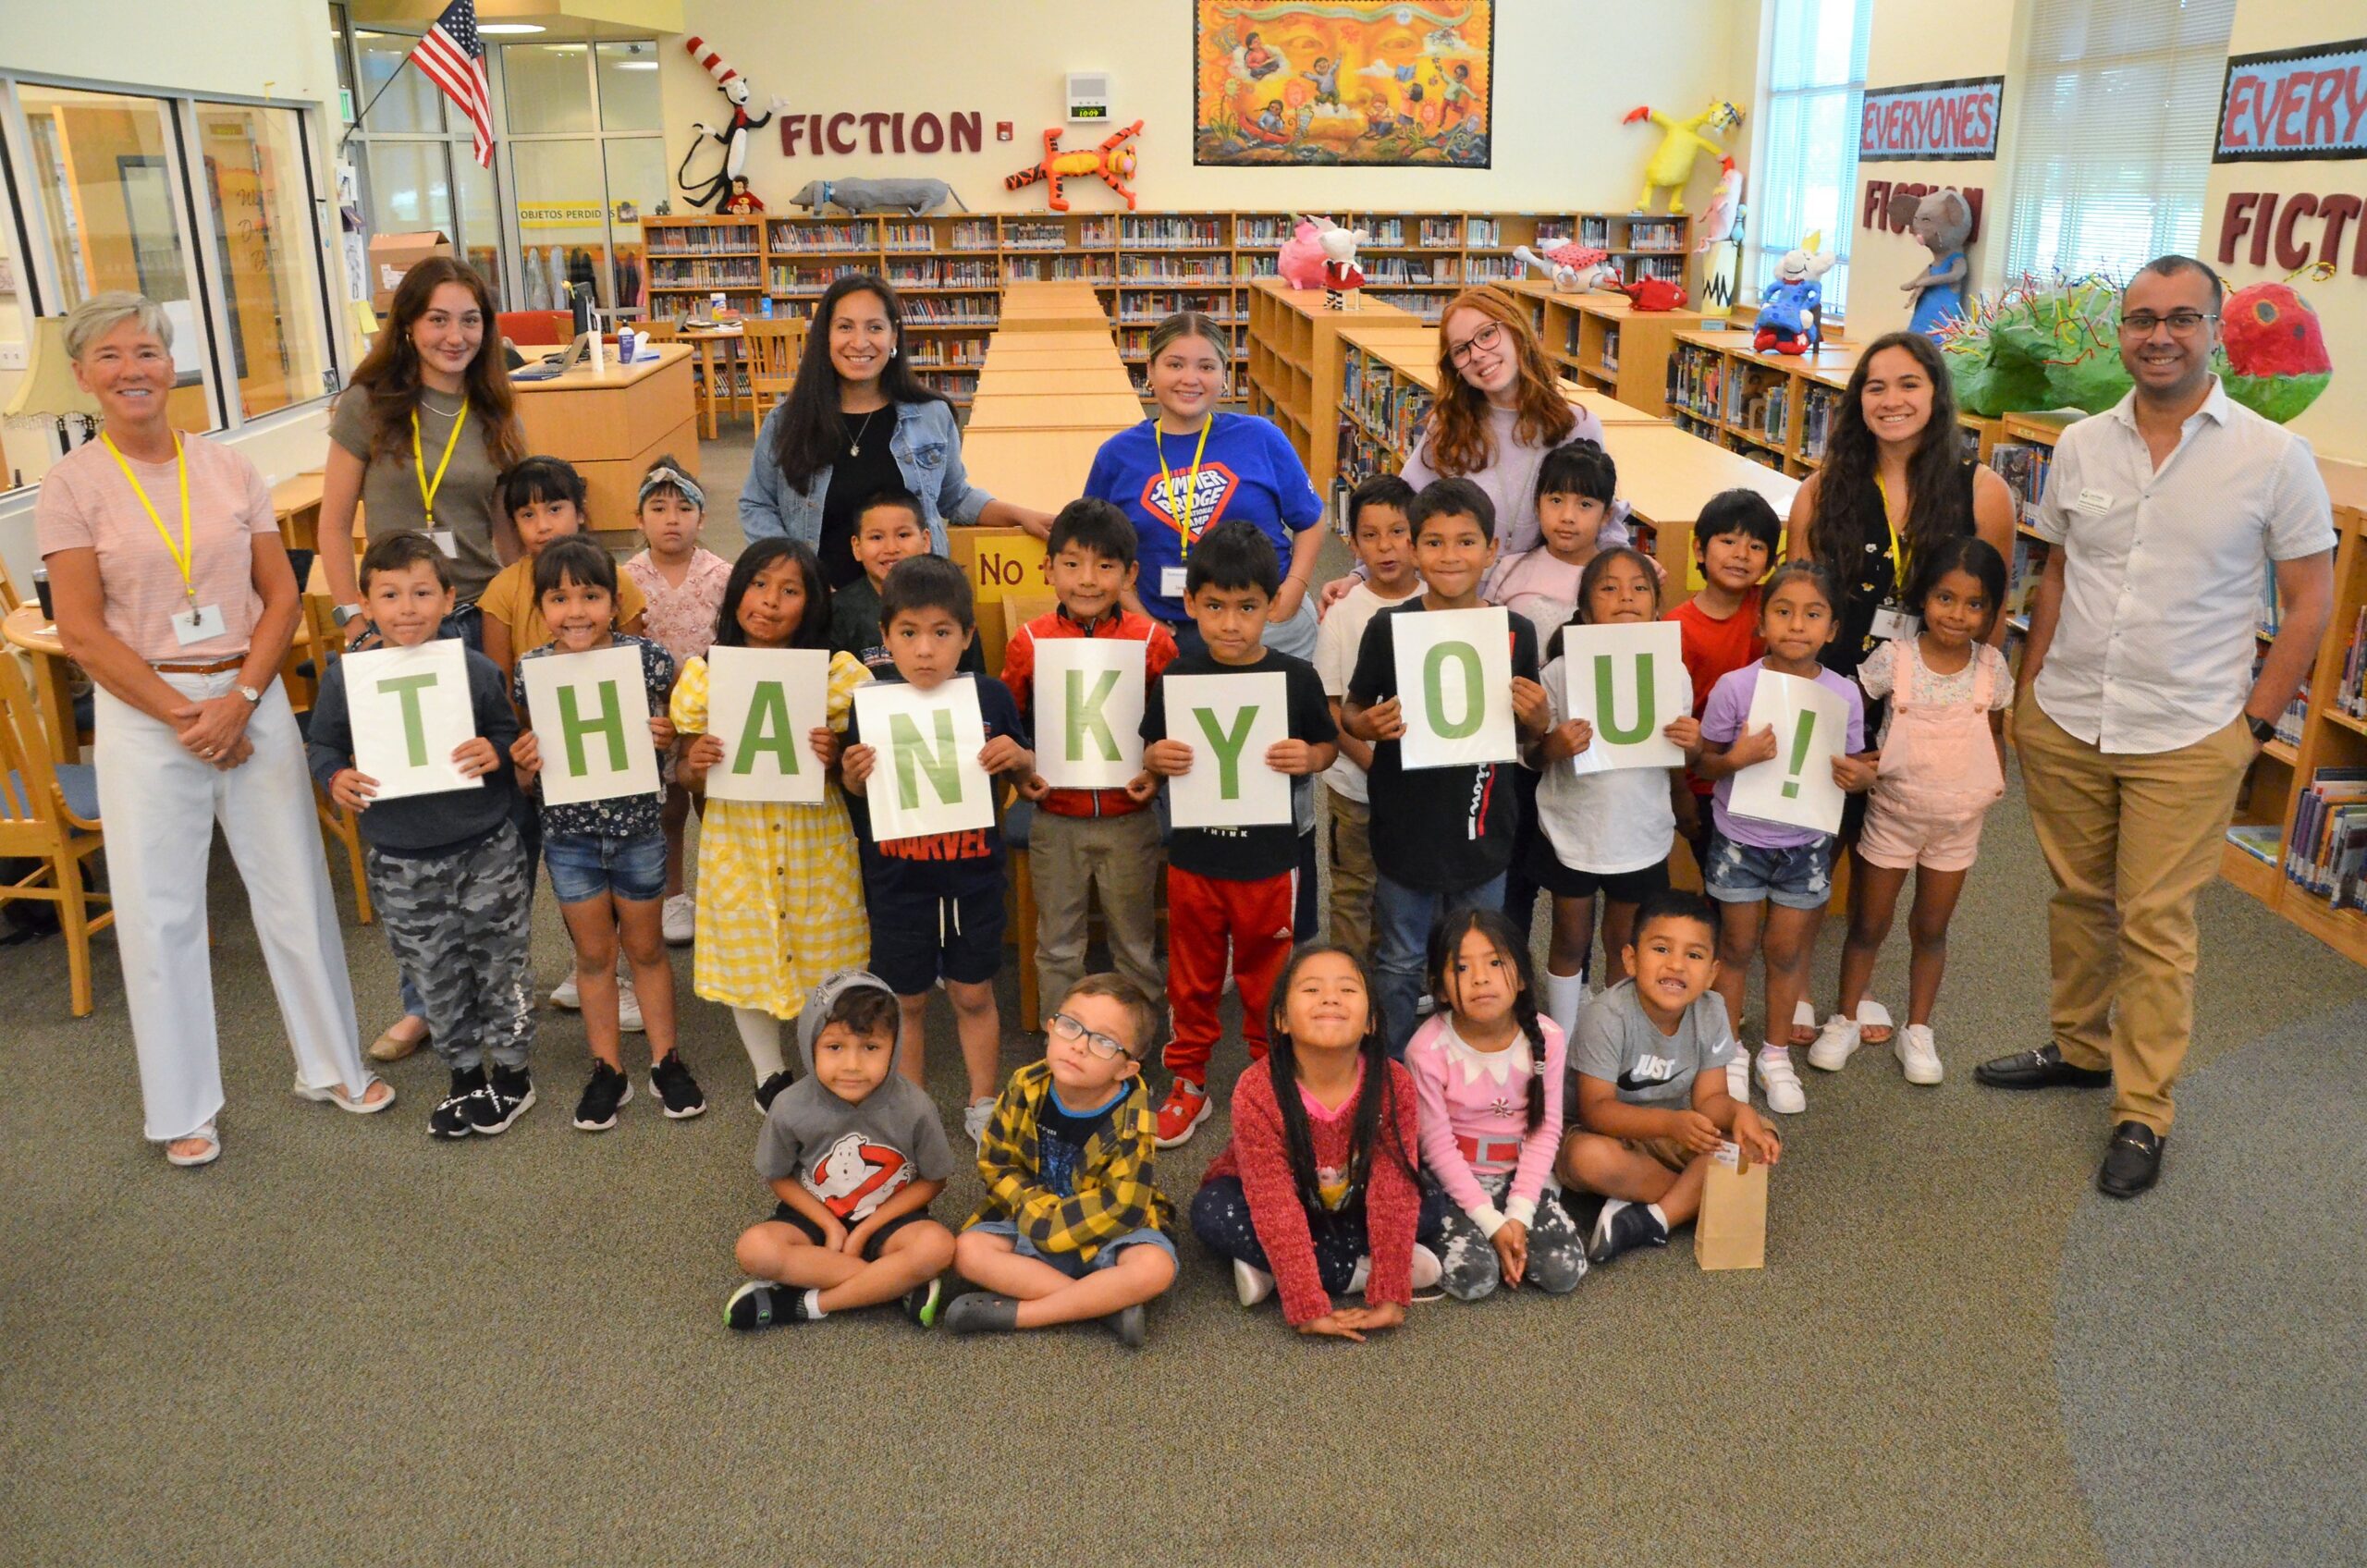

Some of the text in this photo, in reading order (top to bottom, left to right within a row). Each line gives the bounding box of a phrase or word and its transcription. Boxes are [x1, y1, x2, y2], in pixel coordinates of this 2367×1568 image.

[779, 111, 983, 156] FICTION
[521, 209, 616, 220] OBJETOS PERDIDS
[980, 552, 1024, 585] No
[1203, 827, 1248, 838] THINK
[1633, 1054, 1675, 1080] JUST
